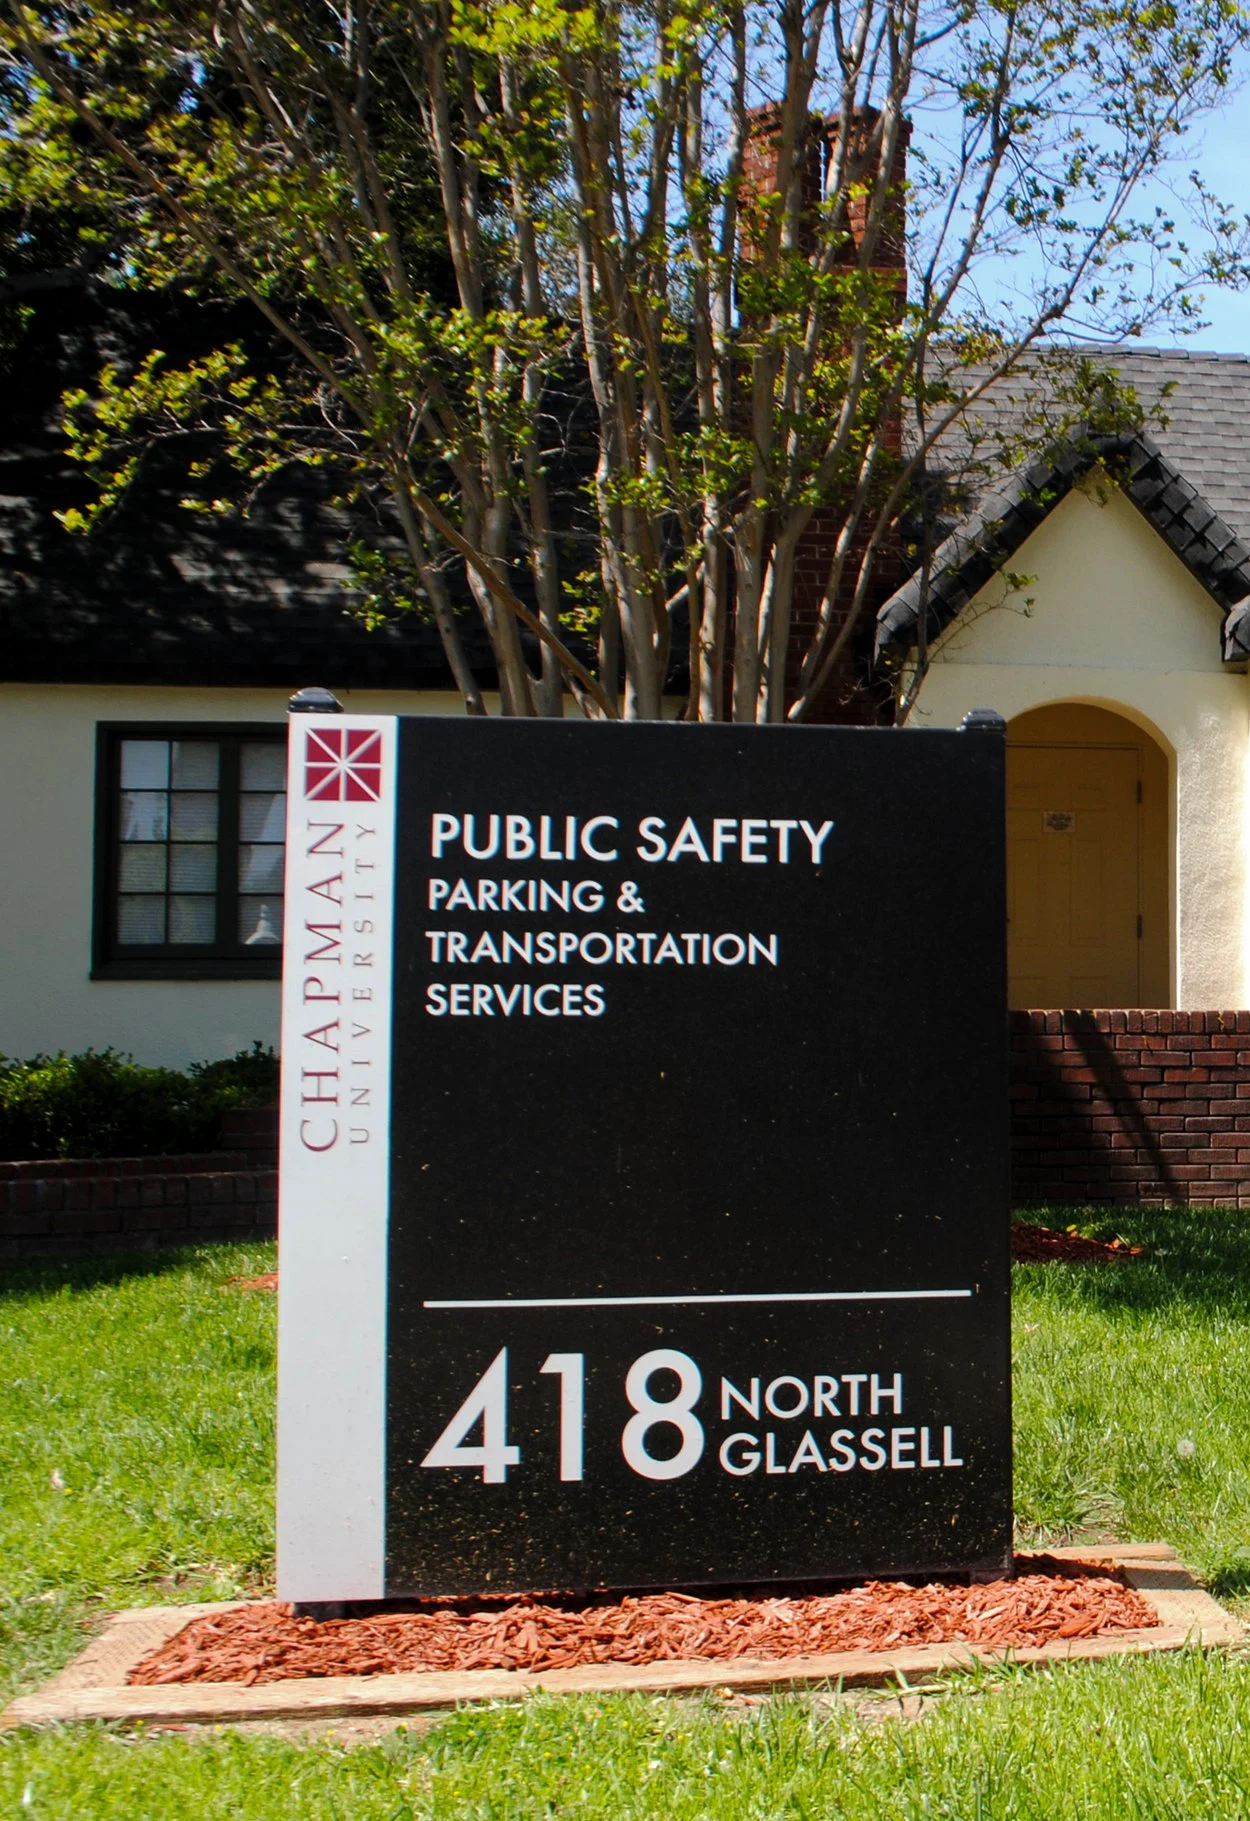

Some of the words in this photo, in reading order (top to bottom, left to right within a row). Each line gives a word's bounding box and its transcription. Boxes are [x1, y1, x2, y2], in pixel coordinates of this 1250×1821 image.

[431, 813, 618, 862] PUBLIC
[636, 816, 834, 864] SAFETY
[428, 878, 605, 912] PARKING
[616, 880, 645, 913] &
[425, 930, 777, 966] TRANSPORTATION
[299, 819, 347, 1153] CHAPMAN
[349, 823, 377, 1145] UNIVERSITY
[425, 983, 606, 1016] SERVICES
[419, 1346, 705, 1484] 418
[720, 1373, 902, 1421] NORTH
[718, 1425, 964, 1476] GLASSELL
